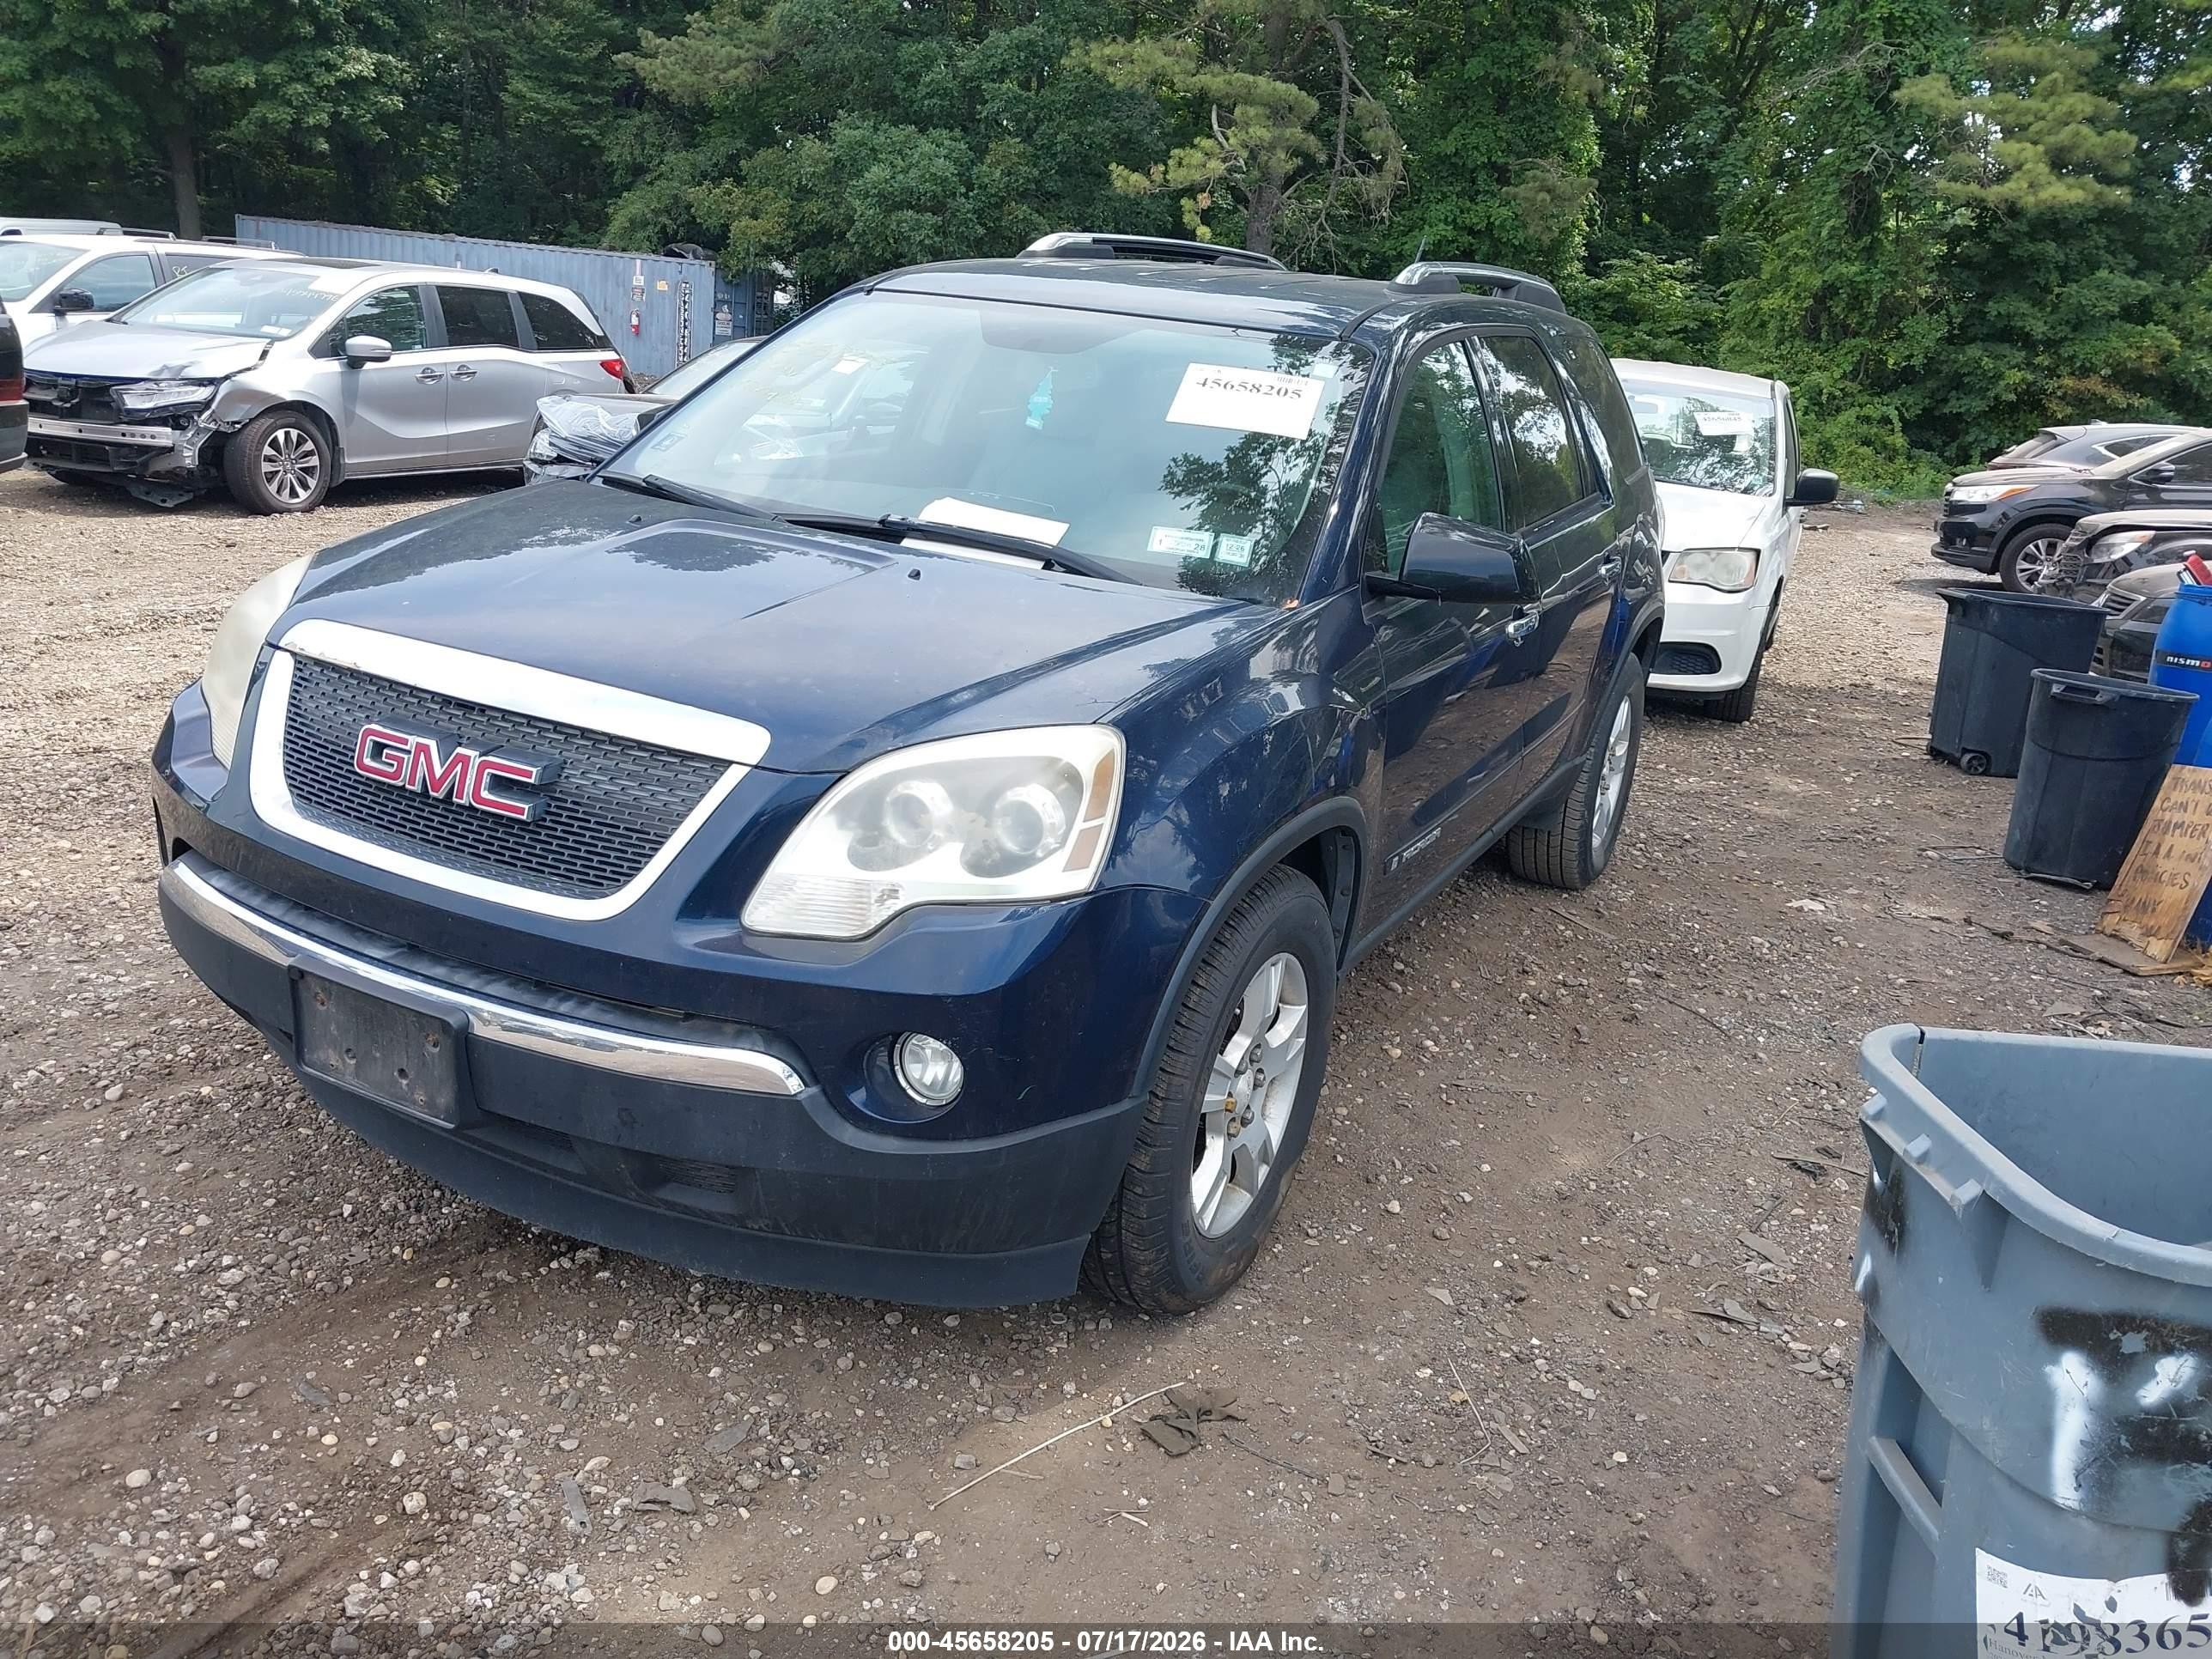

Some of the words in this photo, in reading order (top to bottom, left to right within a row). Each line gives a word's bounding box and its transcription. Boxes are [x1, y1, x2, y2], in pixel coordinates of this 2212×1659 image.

[1195, 376, 1304, 400] 45658205
[1194, 543, 1206, 551] 28
[354, 723, 542, 822] GMC
